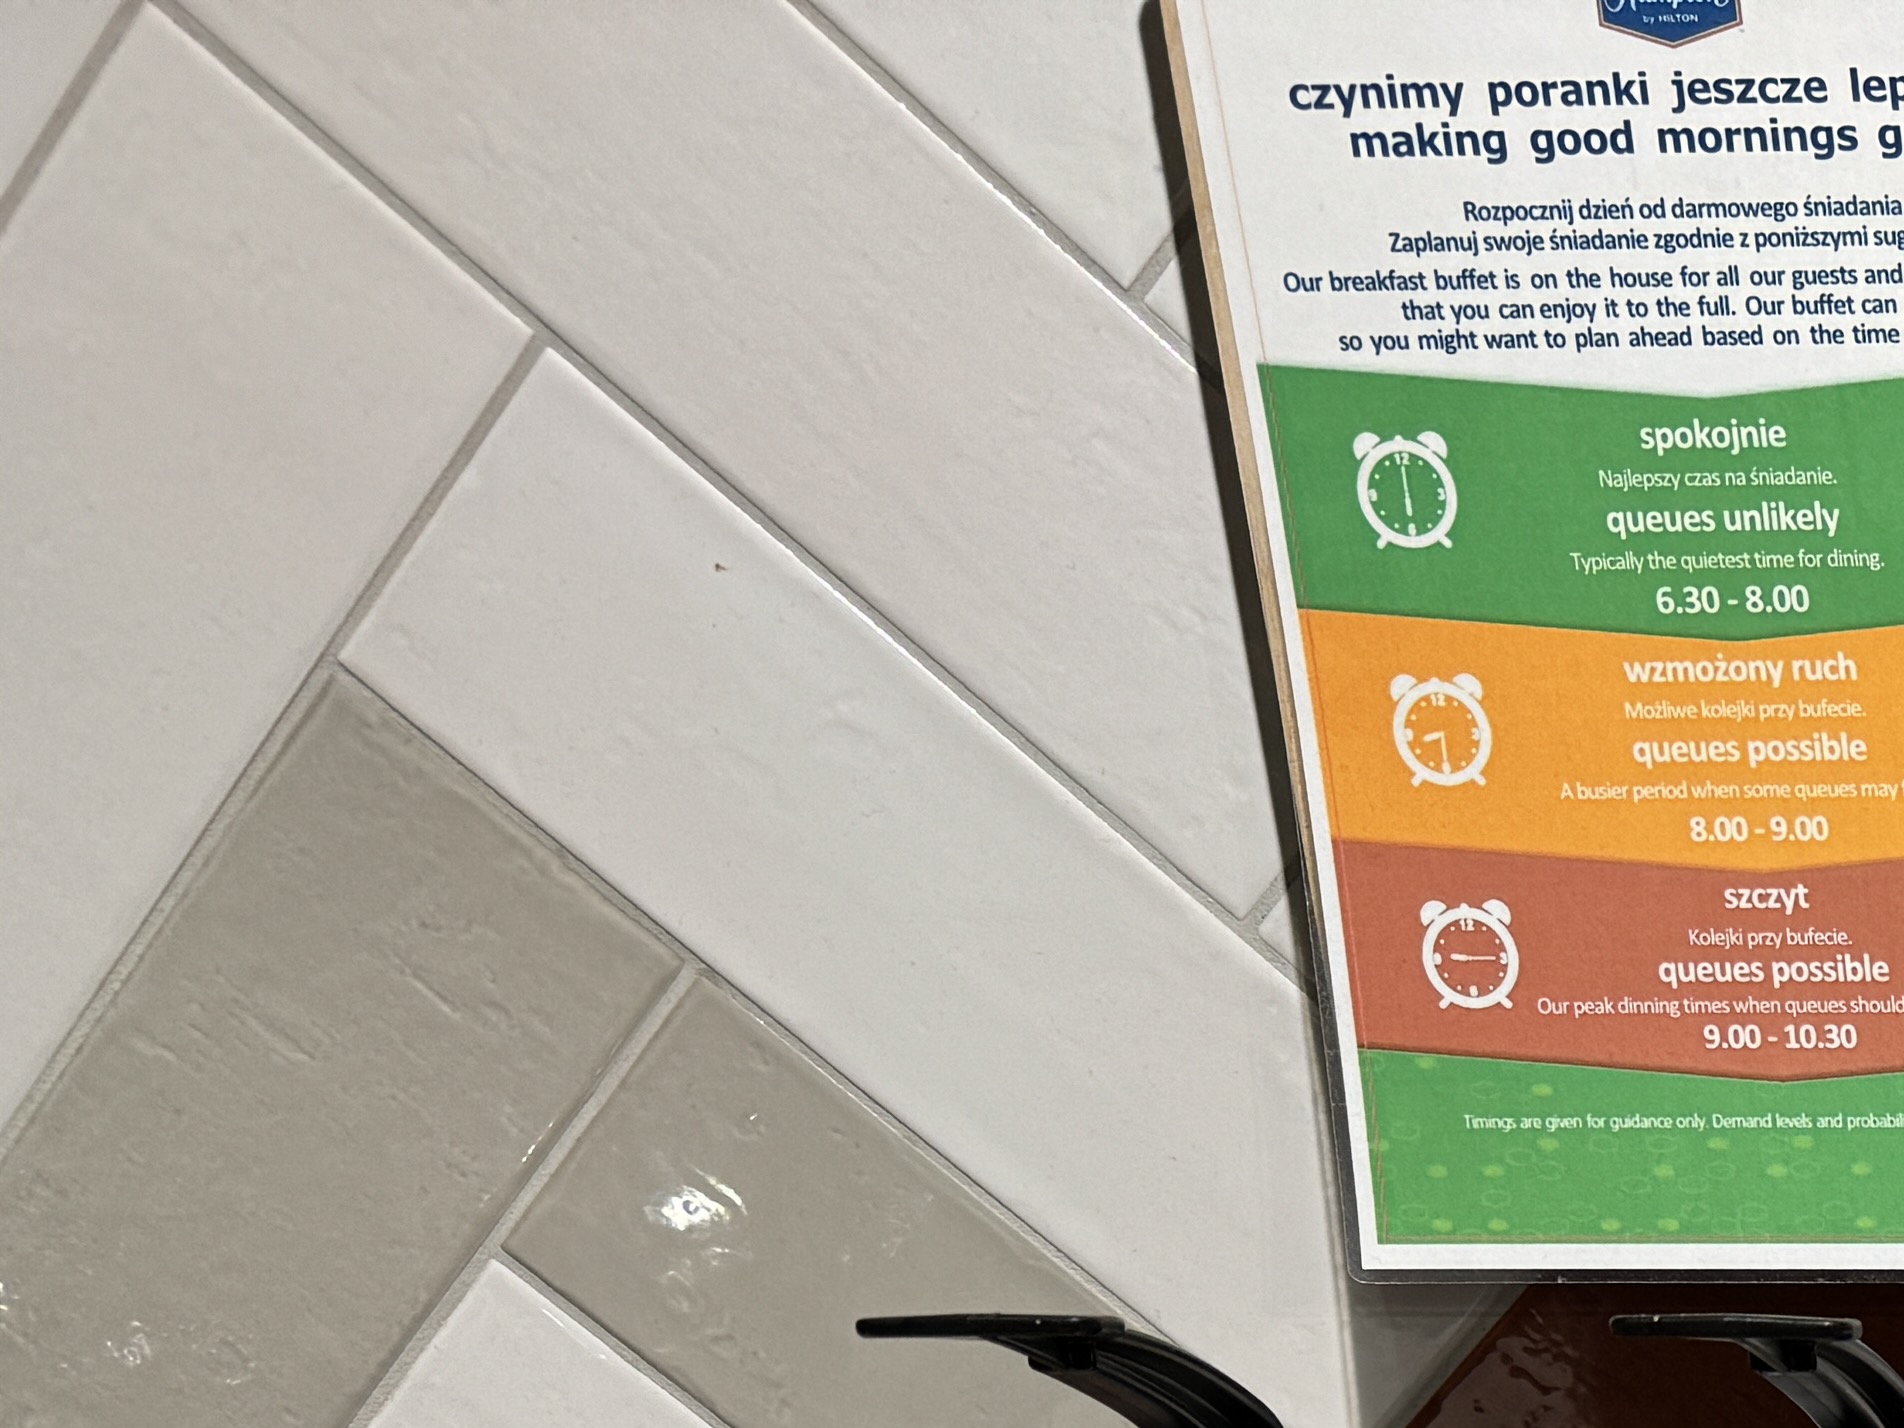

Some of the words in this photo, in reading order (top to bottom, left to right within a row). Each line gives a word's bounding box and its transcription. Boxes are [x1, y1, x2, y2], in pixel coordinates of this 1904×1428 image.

[1658, 14, 1698, 23] HILTON
[1289, 74, 1464, 119] czynimy
[1488, 71, 1649, 116] poranki
[1671, 70, 1828, 114] jeszcze
[1350, 121, 1507, 165] making
[1530, 119, 1634, 164] good
[1657, 117, 1858, 160] mornings
[1463, 198, 1574, 227] Rozpocznij
[1578, 197, 1634, 220] dzień
[1639, 197, 1666, 219] od
[1671, 197, 1798, 222] darmowego
[1388, 230, 1479, 258] Zaplanuj
[1483, 229, 1545, 256] swoje
[1549, 228, 1649, 251] śniadanie
[1653, 227, 1734, 254] zgodnie
[1754, 225, 1868, 253] poniższymi
[1283, 272, 1323, 293] Our
[1328, 269, 1428, 292] breakfast
[1433, 268, 1498, 290] buffet
[1504, 268, 1520, 289] is
[1531, 273, 1558, 289] on
[1565, 266, 1601, 289] the
[1609, 266, 1673, 288] house
[1679, 265, 1710, 287] for
[1716, 265, 1740, 287] all
[1750, 270, 1786, 286] our
[1792, 266, 1858, 290] guests
[1864, 262, 1903, 284] and
[1339, 335, 1363, 352] so
[1369, 335, 1410, 356] you
[1418, 328, 1479, 355] might
[1483, 330, 1539, 349] want
[1544, 330, 1566, 349] to
[1575, 326, 1619, 353] plan
[1629, 325, 1692, 347] ahead
[1701, 324, 1763, 346] based
[1773, 329, 1800, 345] on
[1809, 323, 1845, 345] the
[1852, 323, 1900, 344] time
[1640, 418, 1786, 456] spokojnie
[1598, 468, 1681, 492] Najlepszy
[1684, 472, 1721, 486] czas
[1725, 472, 1746, 486] na
[1750, 466, 1837, 485] śniadanie.
[1607, 510, 1716, 540] queues
[1723, 500, 1839, 537] unlikely
[1569, 551, 1644, 575] Typically
[1647, 550, 1677, 569] the
[1681, 551, 1751, 573] quietest
[1754, 550, 1794, 568] time
[1797, 548, 1823, 567] for
[1827, 548, 1885, 571] dining.
[1656, 586, 1720, 614] 6.30
[1745, 584, 1809, 613] 8.00
[1623, 653, 1784, 688] wzmożony
[1792, 651, 1857, 681] ruch
[1624, 700, 1698, 719] Możliwe
[1701, 699, 1755, 722] kolejki
[1759, 704, 1796, 721] przy
[1798, 698, 1866, 717] bufecie.
[1632, 740, 1740, 769] queues
[1747, 732, 1867, 768] possible
[1576, 782, 1629, 800] busier
[1632, 780, 1688, 803] period
[1691, 780, 1740, 798] when
[1743, 784, 1791, 798] some
[1794, 783, 1858, 801] queues
[1860, 783, 1899, 801] may
[1690, 816, 1748, 842] 8.00
[1769, 815, 1829, 841] 9.00
[1724, 883, 1810, 915] szczyt
[1688, 928, 1743, 949] Kolejki
[1747, 932, 1782, 949] przy
[1786, 927, 1852, 945] bufecie.
[1658, 962, 1764, 989] queues
[1772, 953, 1889, 989] possible
[1537, 997, 1570, 1014] Our
[1573, 996, 1615, 1018] peak
[1618, 996, 1681, 1018] dinning
[1683, 997, 1730, 1014] times
[1732, 996, 1781, 1013] when
[1785, 1000, 1847, 1017] queues
[1703, 1024, 1761, 1049] 9.00
[1784, 1024, 1857, 1049] 10.30
[1464, 1114, 1517, 1132] Timings
[1520, 1118, 1542, 1129] are
[1545, 1117, 1582, 1132] given
[1586, 1113, 1606, 1128] for
[1610, 1113, 1673, 1132] guidance
[1676, 1113, 1709, 1131] only.
